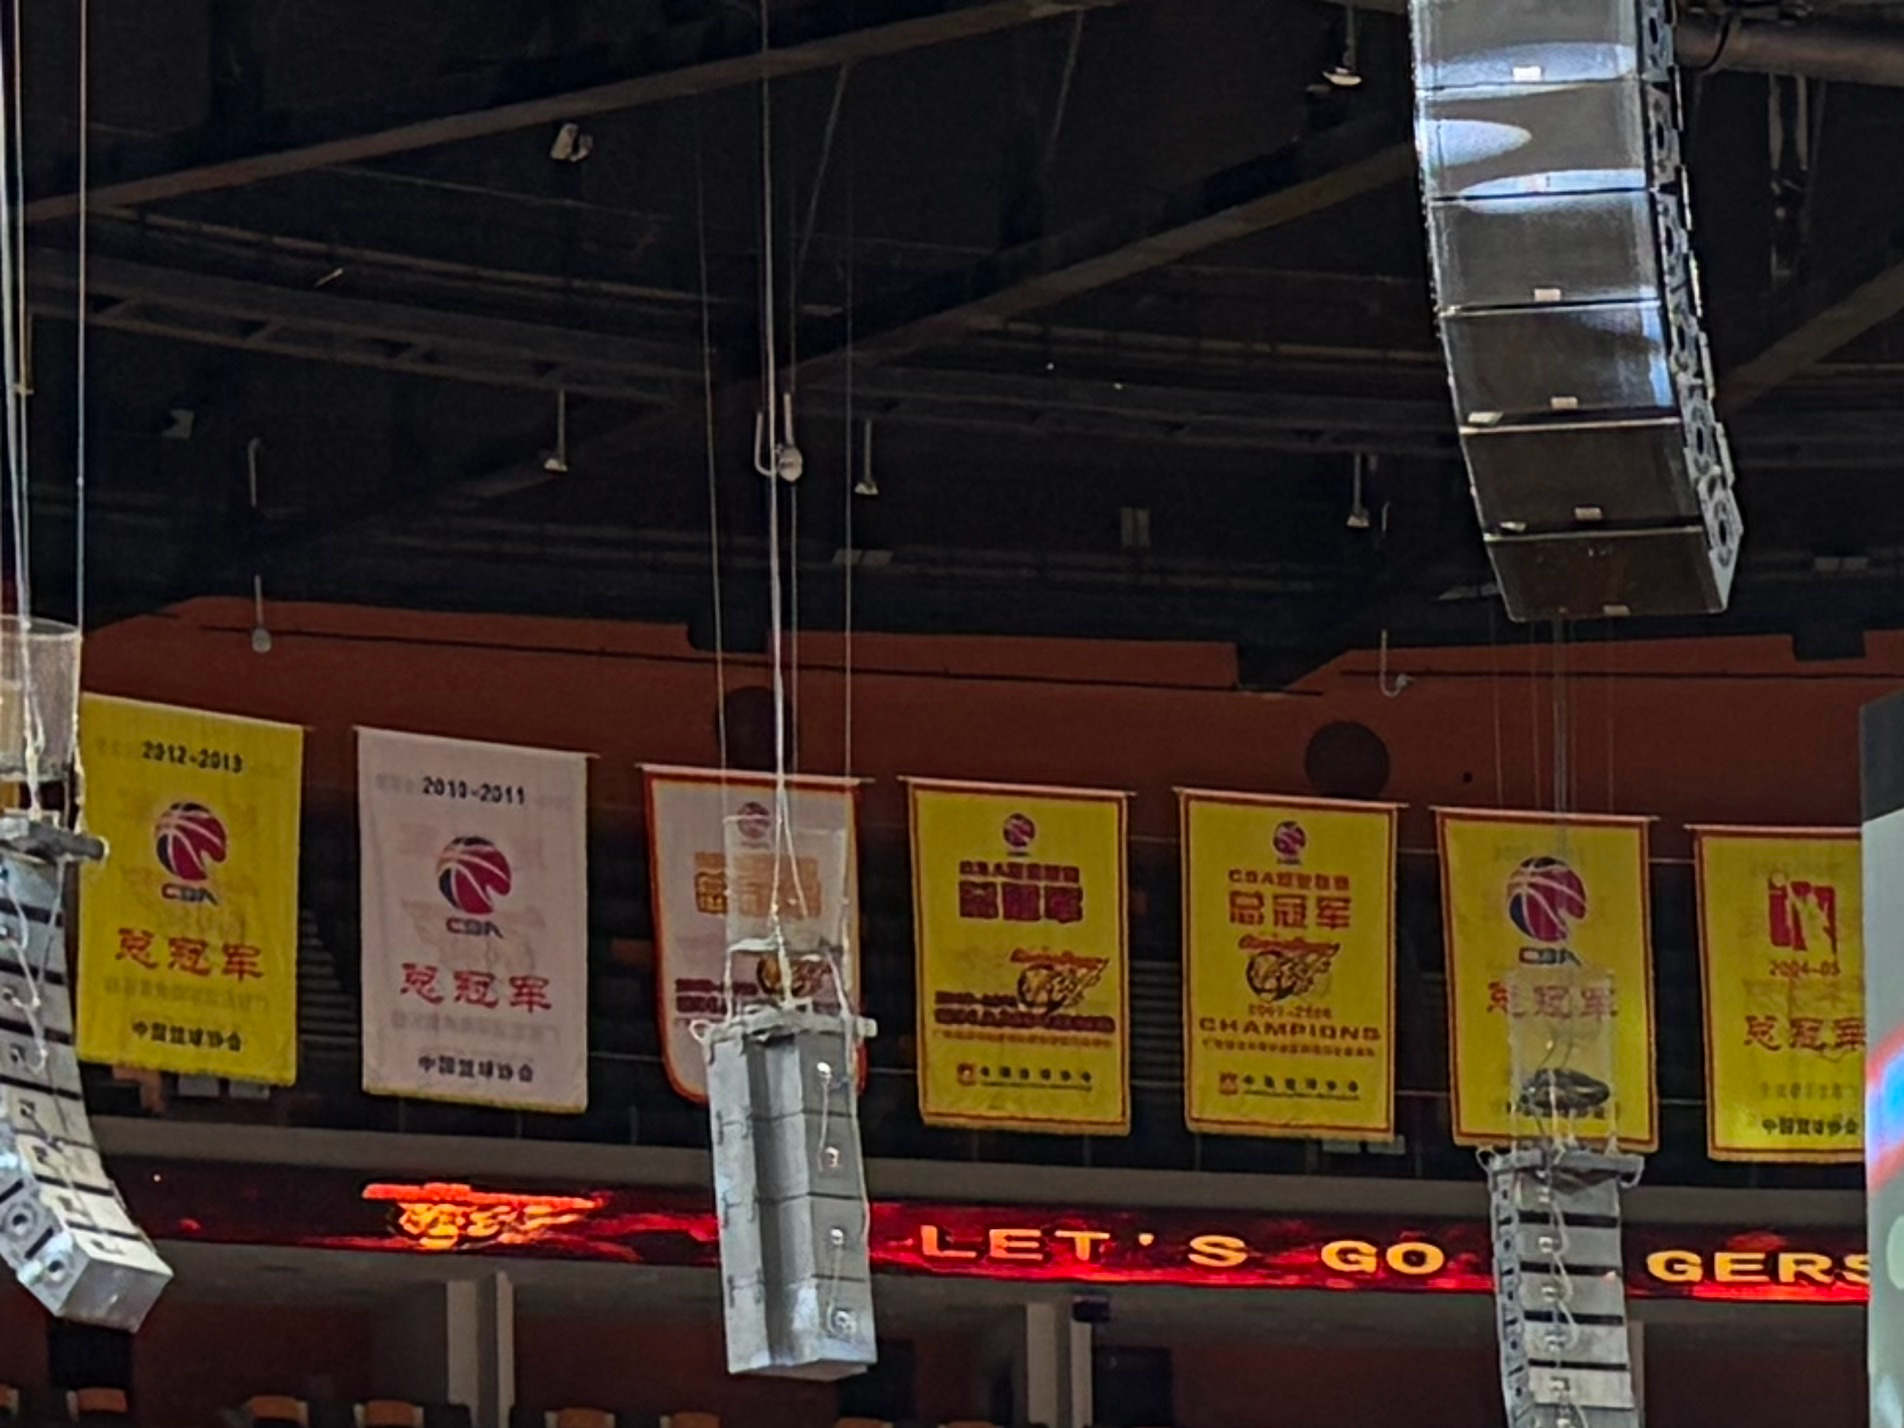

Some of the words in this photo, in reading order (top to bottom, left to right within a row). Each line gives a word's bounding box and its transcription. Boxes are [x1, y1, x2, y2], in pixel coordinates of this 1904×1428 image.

[142, 740, 244, 774] 2012-2013
[421, 776, 526, 805] 2010-2011
[919, 1224, 1250, 1270] LET'S
[1320, 1240, 1447, 1277] GO
